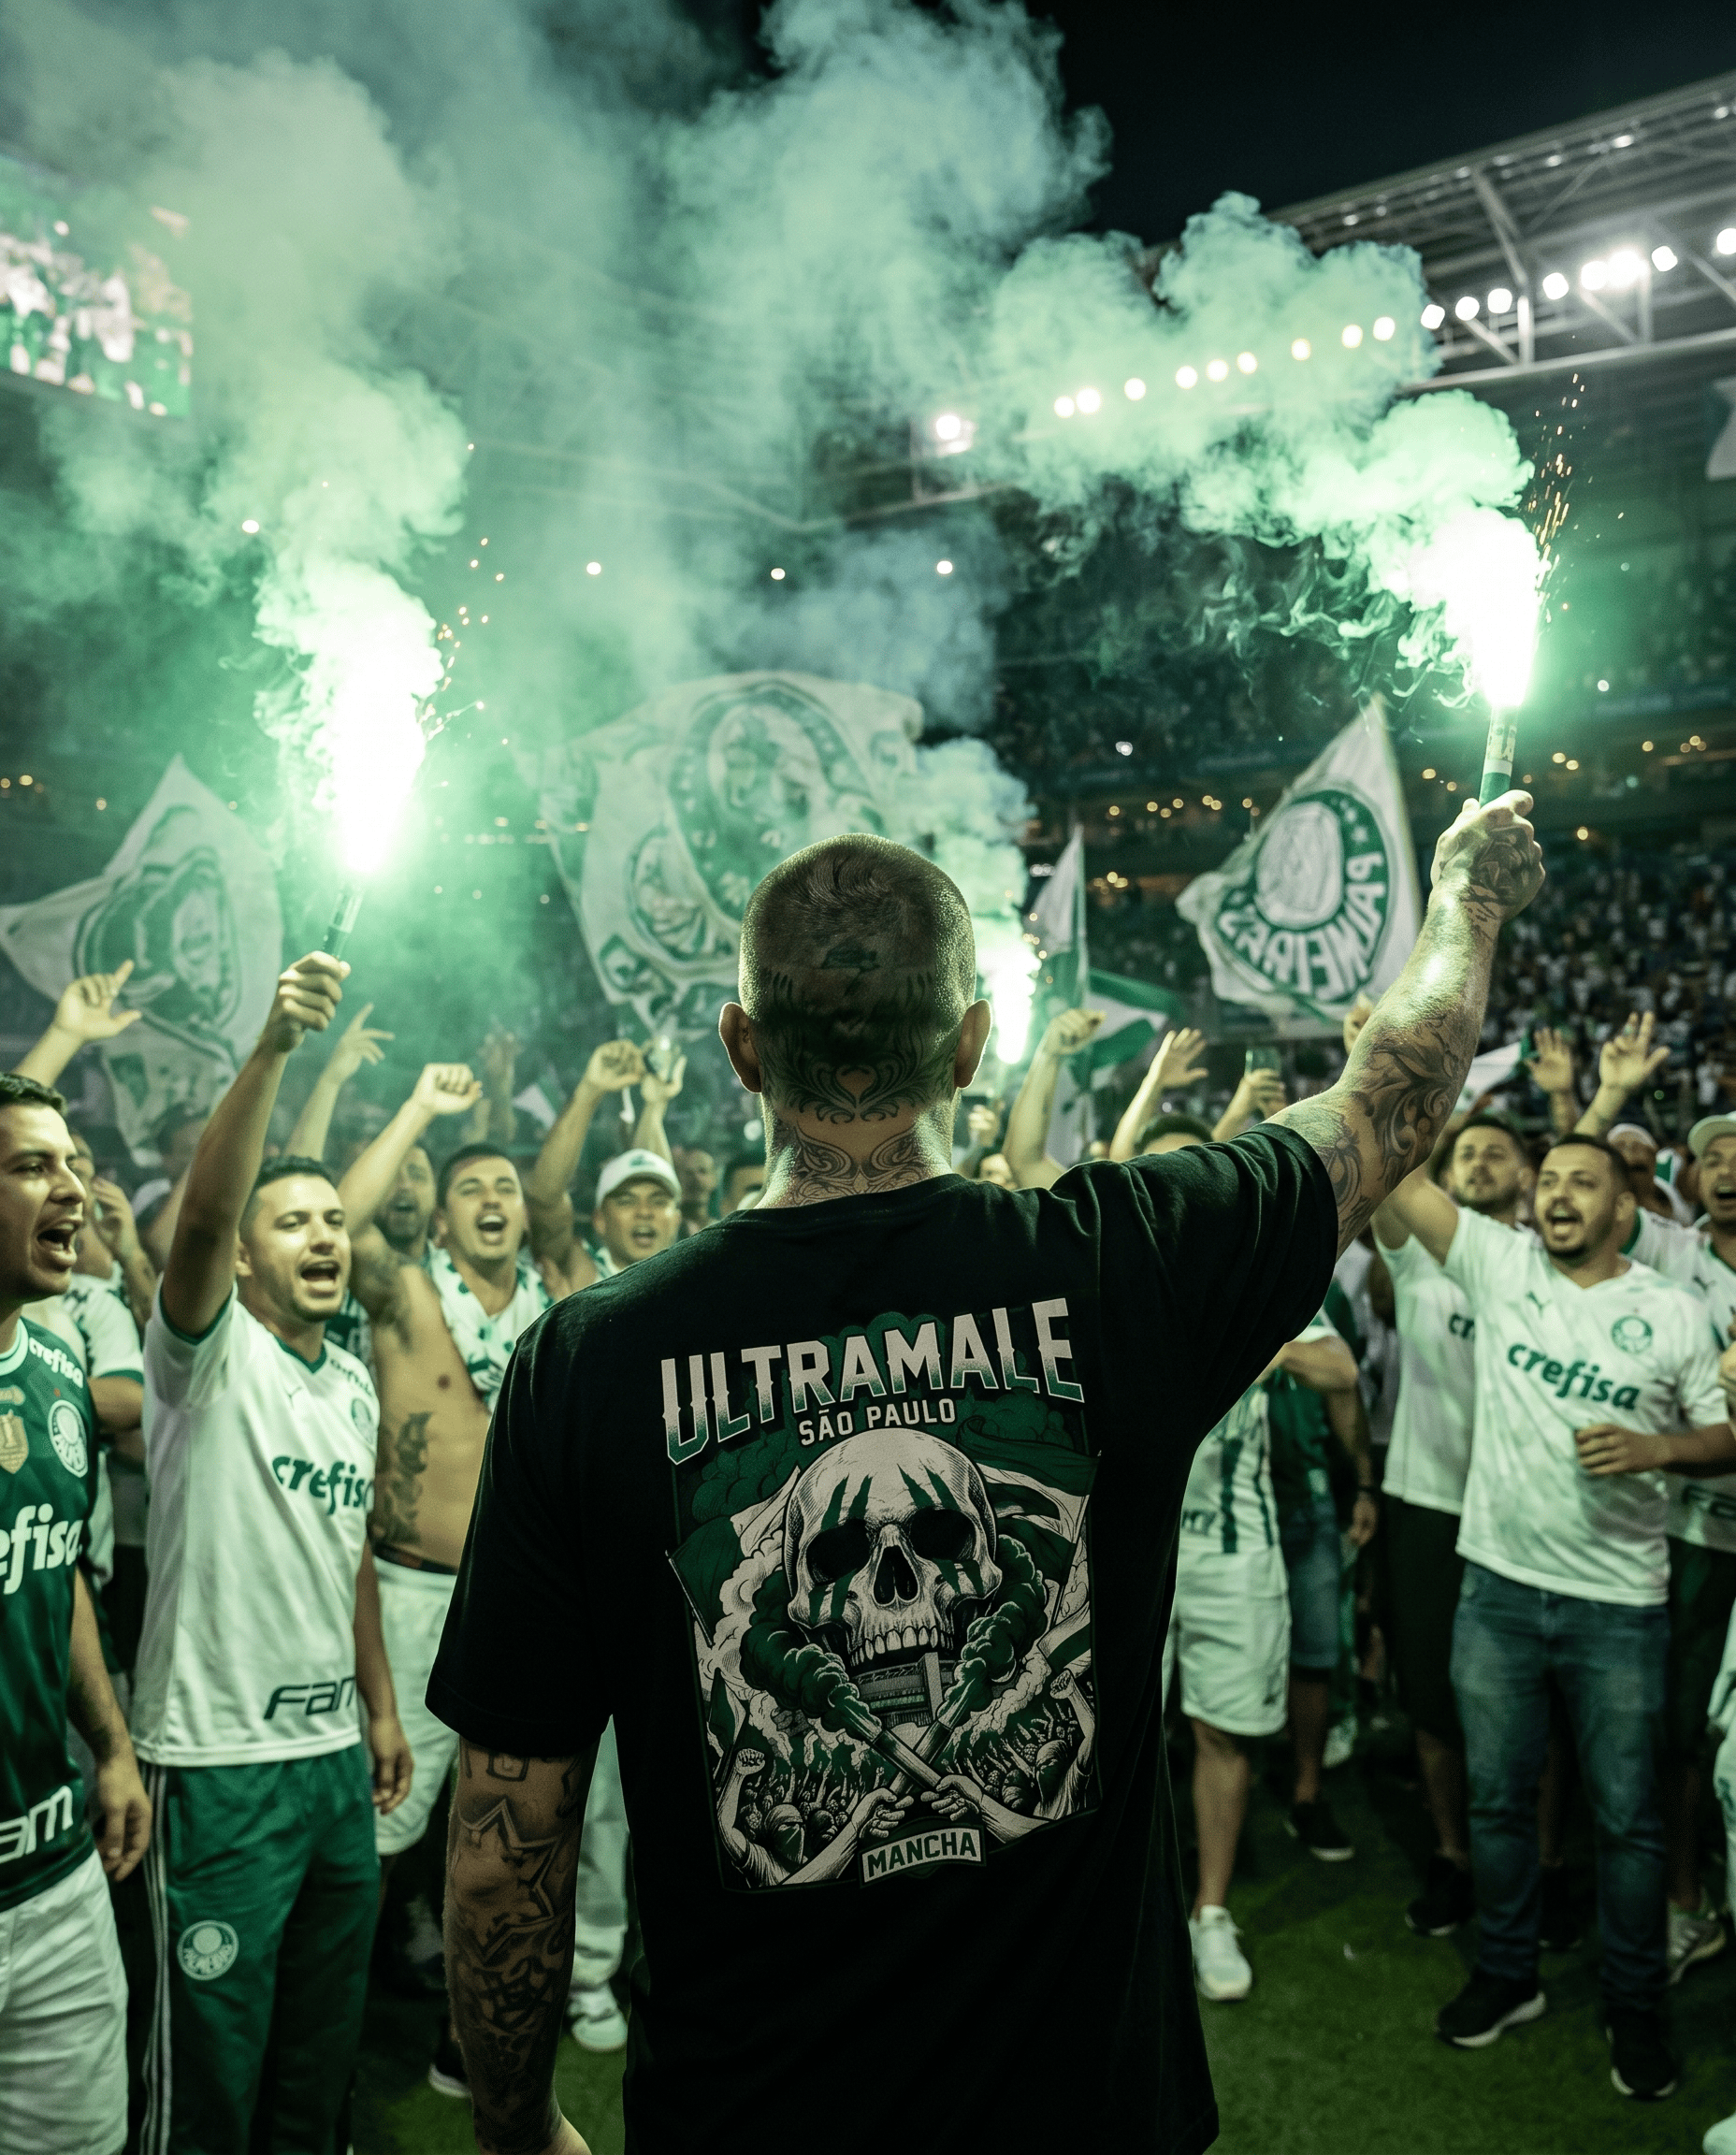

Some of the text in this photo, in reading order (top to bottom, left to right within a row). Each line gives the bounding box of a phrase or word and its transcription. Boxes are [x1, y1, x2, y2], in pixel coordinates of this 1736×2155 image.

[29, 1337, 84, 1389] crefisa
[661, 1297, 1084, 1466] ULTRAMALE
[1507, 1343, 1640, 1411] crefisa
[799, 1398, 956, 1446] SÃO PAULO
[867, 1831, 977, 1878] MANCHA
